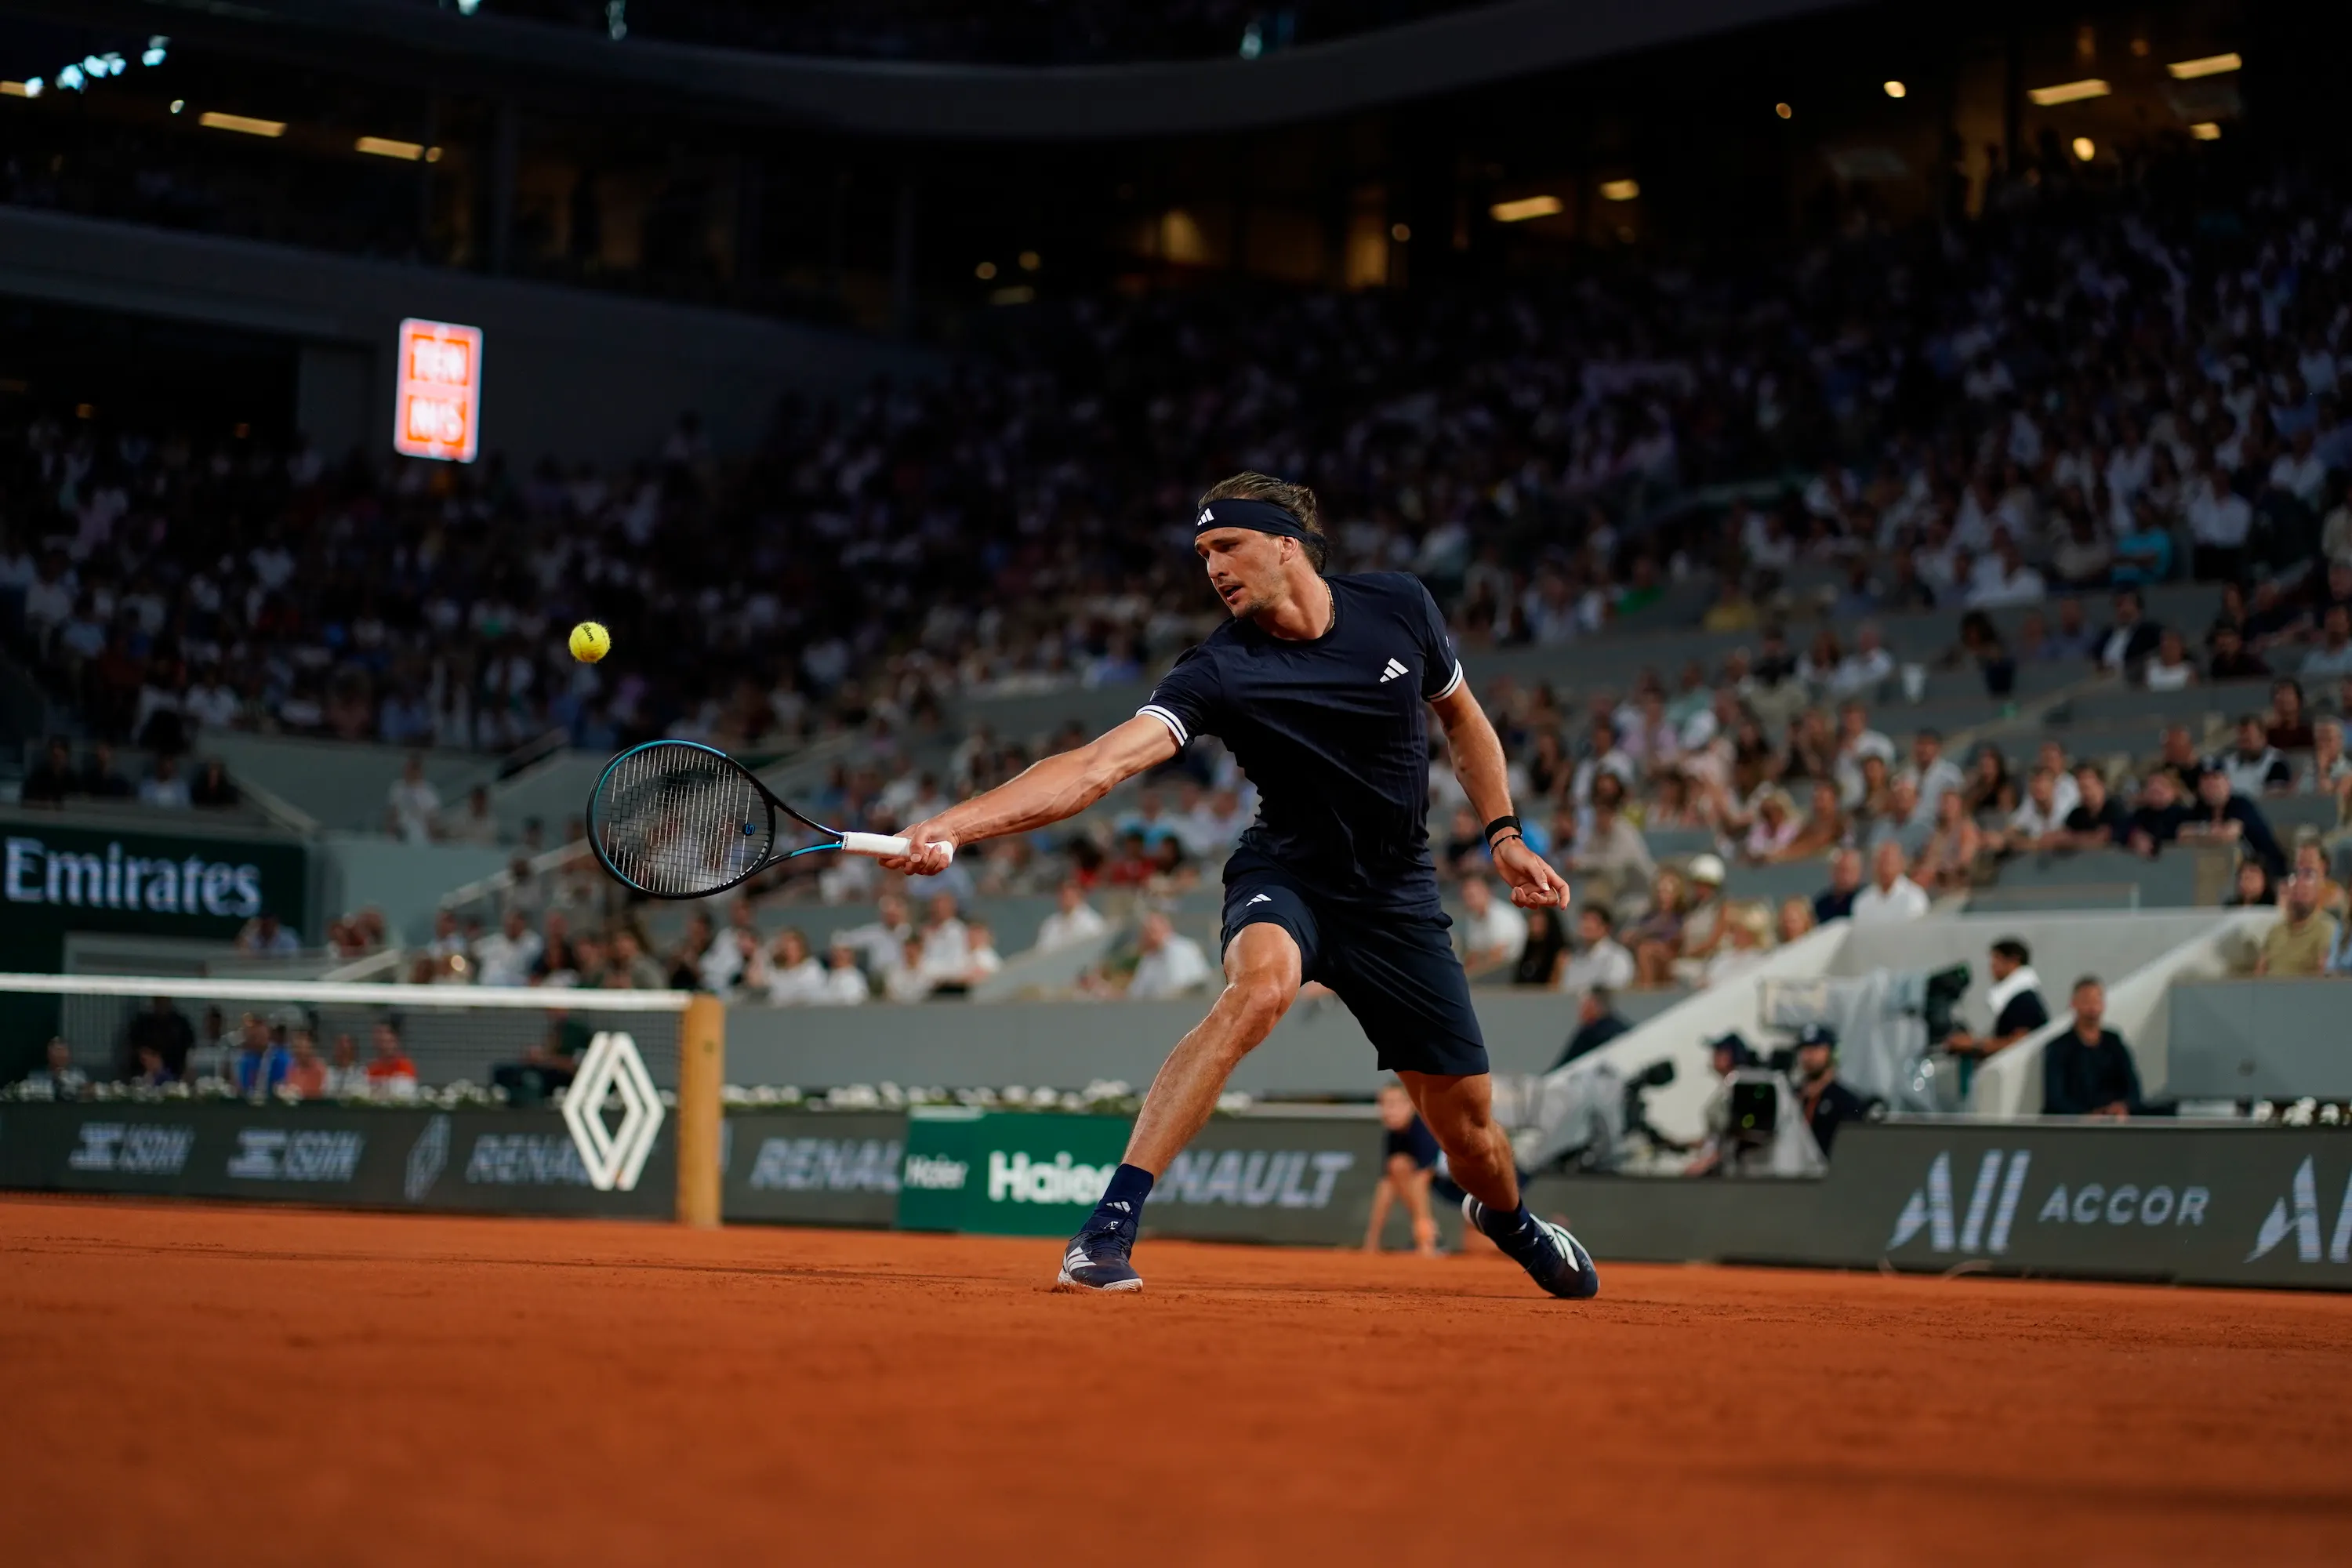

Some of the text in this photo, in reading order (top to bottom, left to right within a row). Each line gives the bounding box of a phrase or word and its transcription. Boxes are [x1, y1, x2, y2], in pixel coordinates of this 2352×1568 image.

[5, 836, 263, 918] Emirates
[1148, 1149, 1356, 1208] NAULT
[2038, 1182, 2211, 1226] ACCOR
[2242, 1153, 2352, 1264] Al
